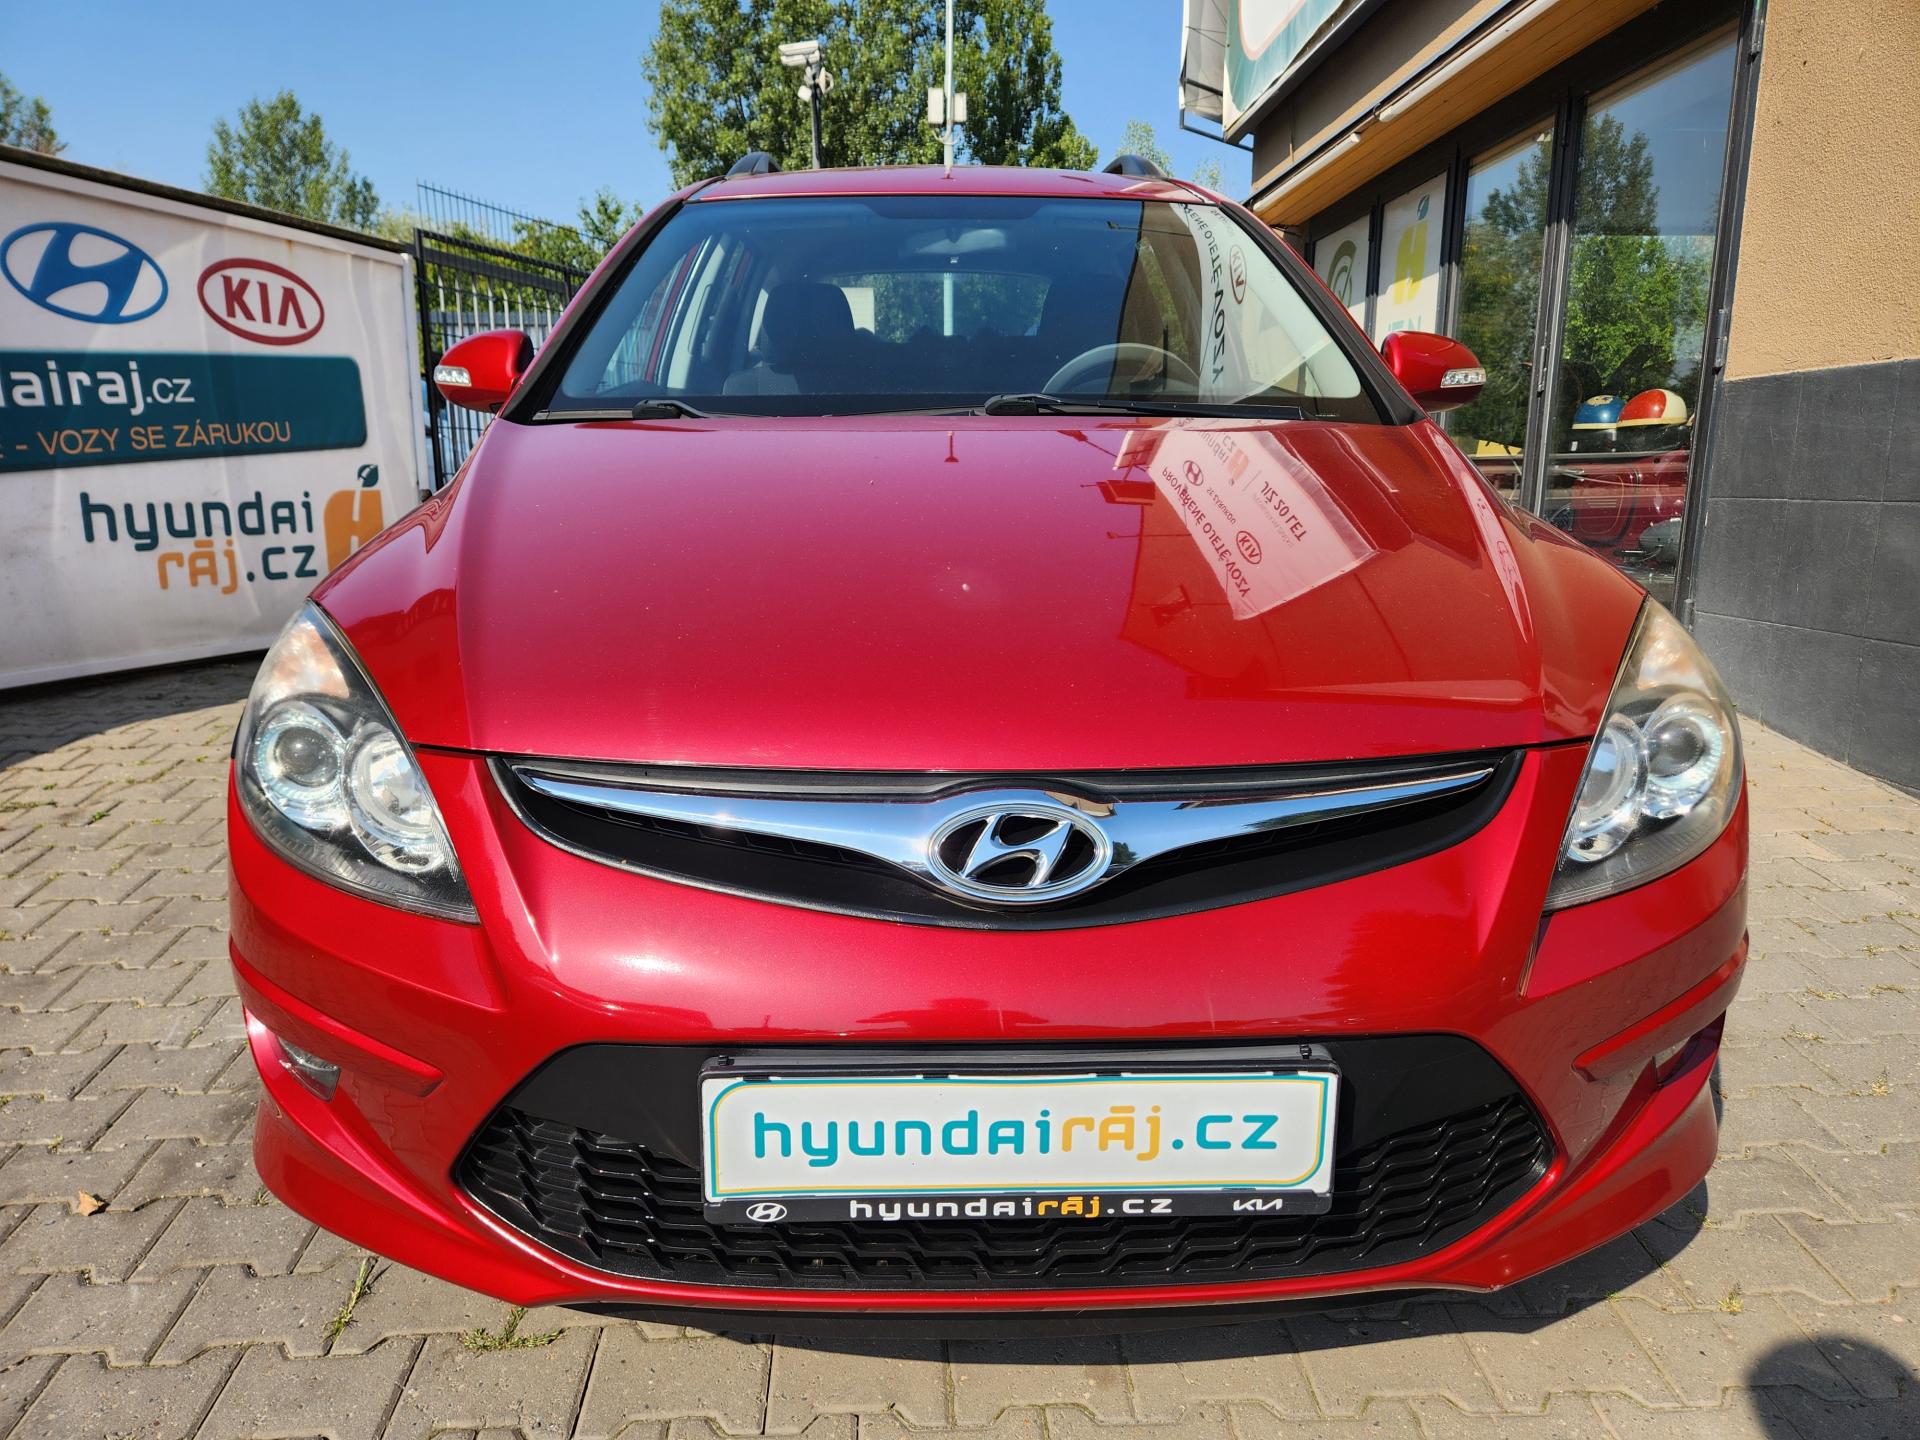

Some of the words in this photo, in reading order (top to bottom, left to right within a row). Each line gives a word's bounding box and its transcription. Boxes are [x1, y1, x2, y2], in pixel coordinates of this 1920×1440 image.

[220, 274, 307, 329] KIA
[0, 360, 195, 416] airaj.cz
[36, 427, 119, 455] VOZY
[130, 425, 166, 450] SE
[173, 419, 291, 447] ZÁRUKOU
[80, 491, 313, 551] hyundai
